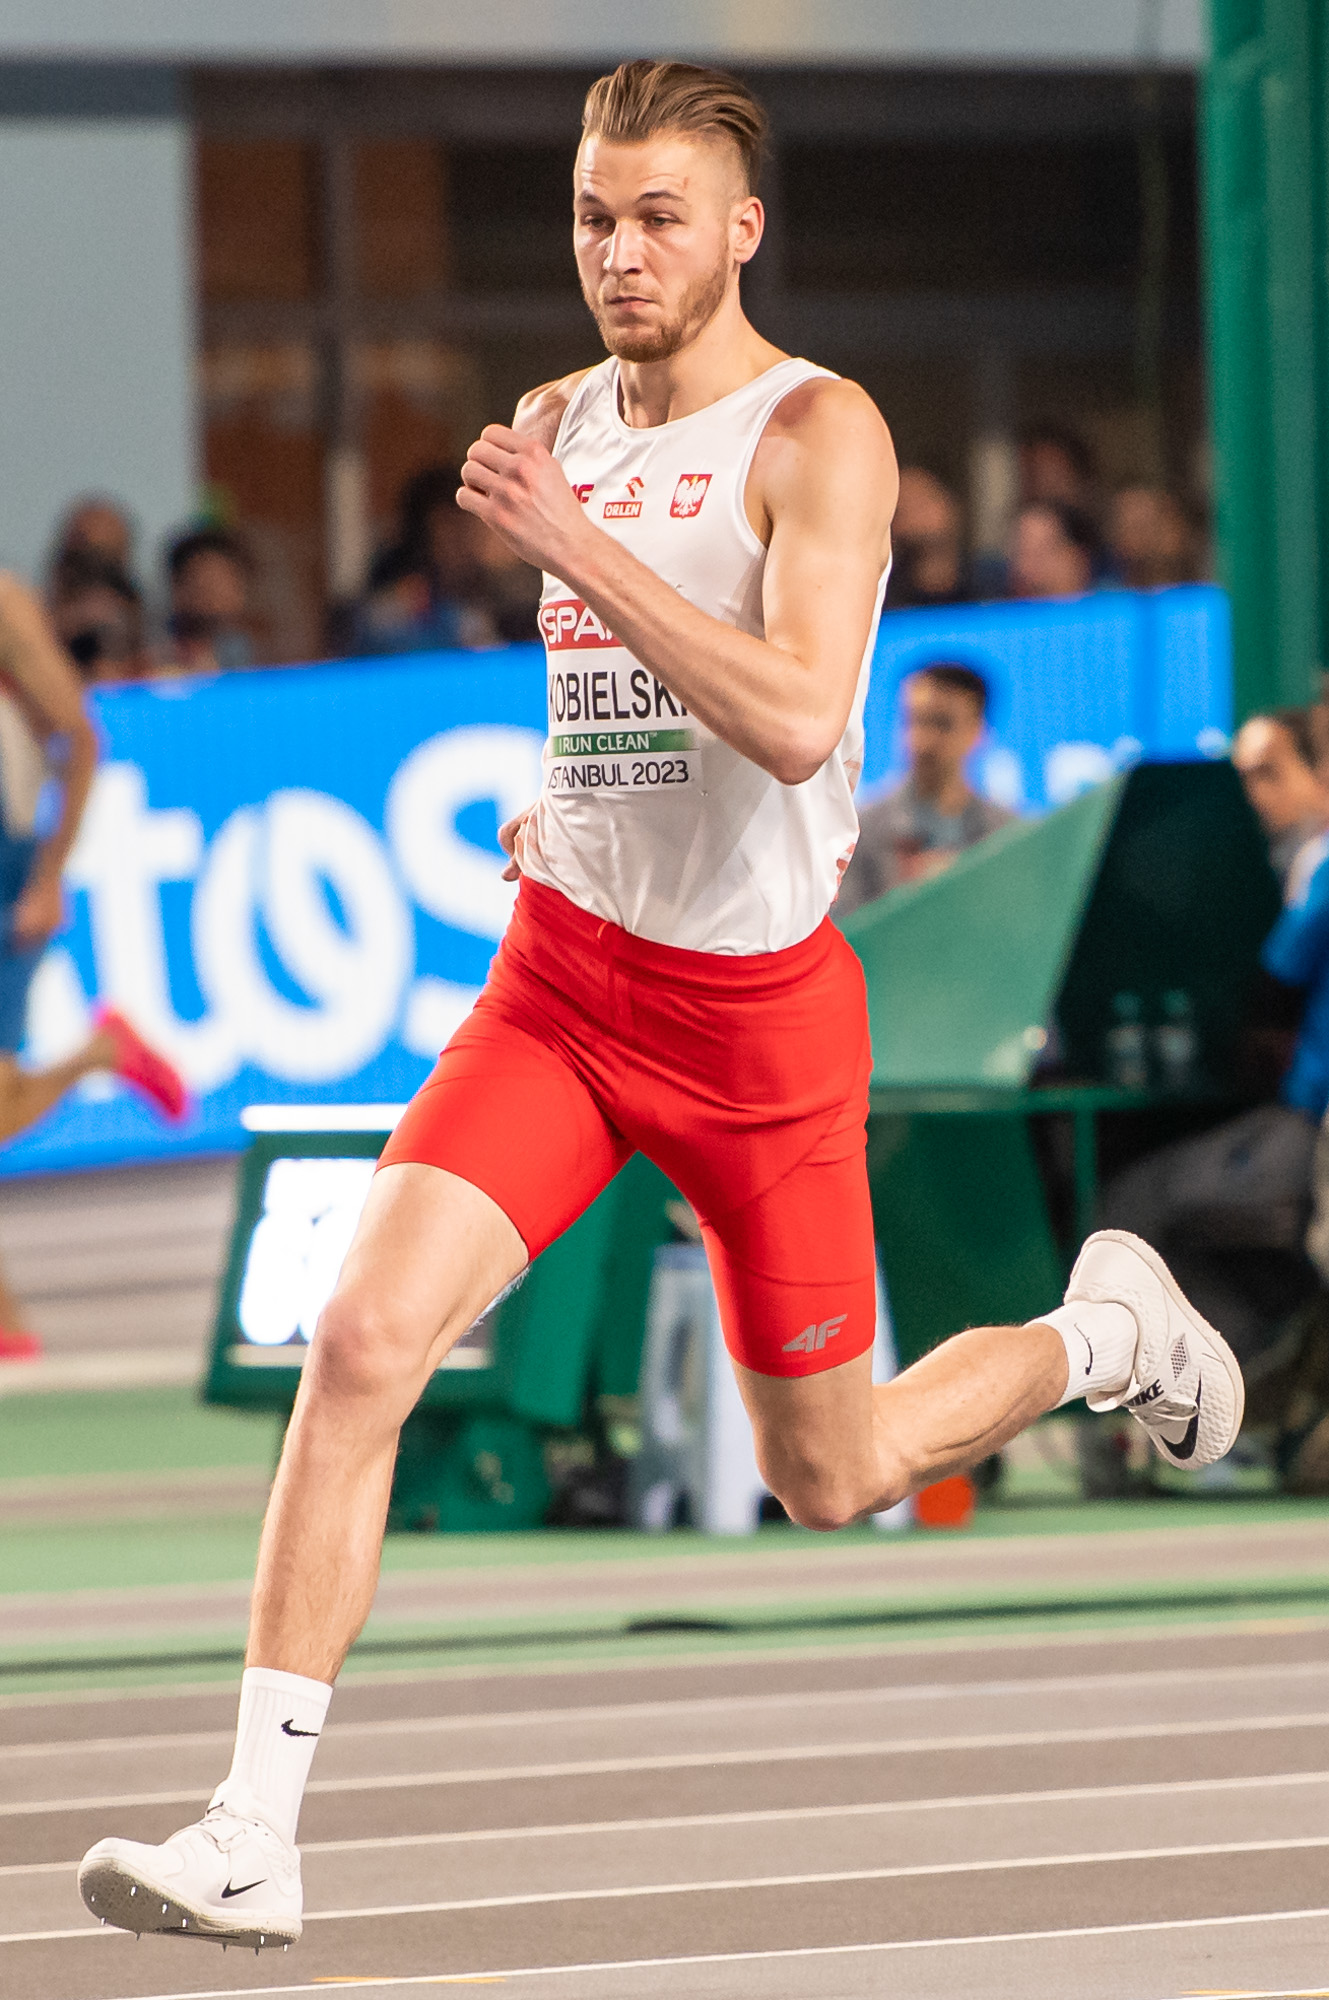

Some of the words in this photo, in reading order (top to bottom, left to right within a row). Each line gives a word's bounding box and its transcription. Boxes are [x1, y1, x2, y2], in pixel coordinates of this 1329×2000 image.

[605, 502, 641, 517] ORLEN
[541, 606, 613, 645] SPA
[549, 669, 688, 723] KOBIELSK
[631, 760, 689, 785] 2023
